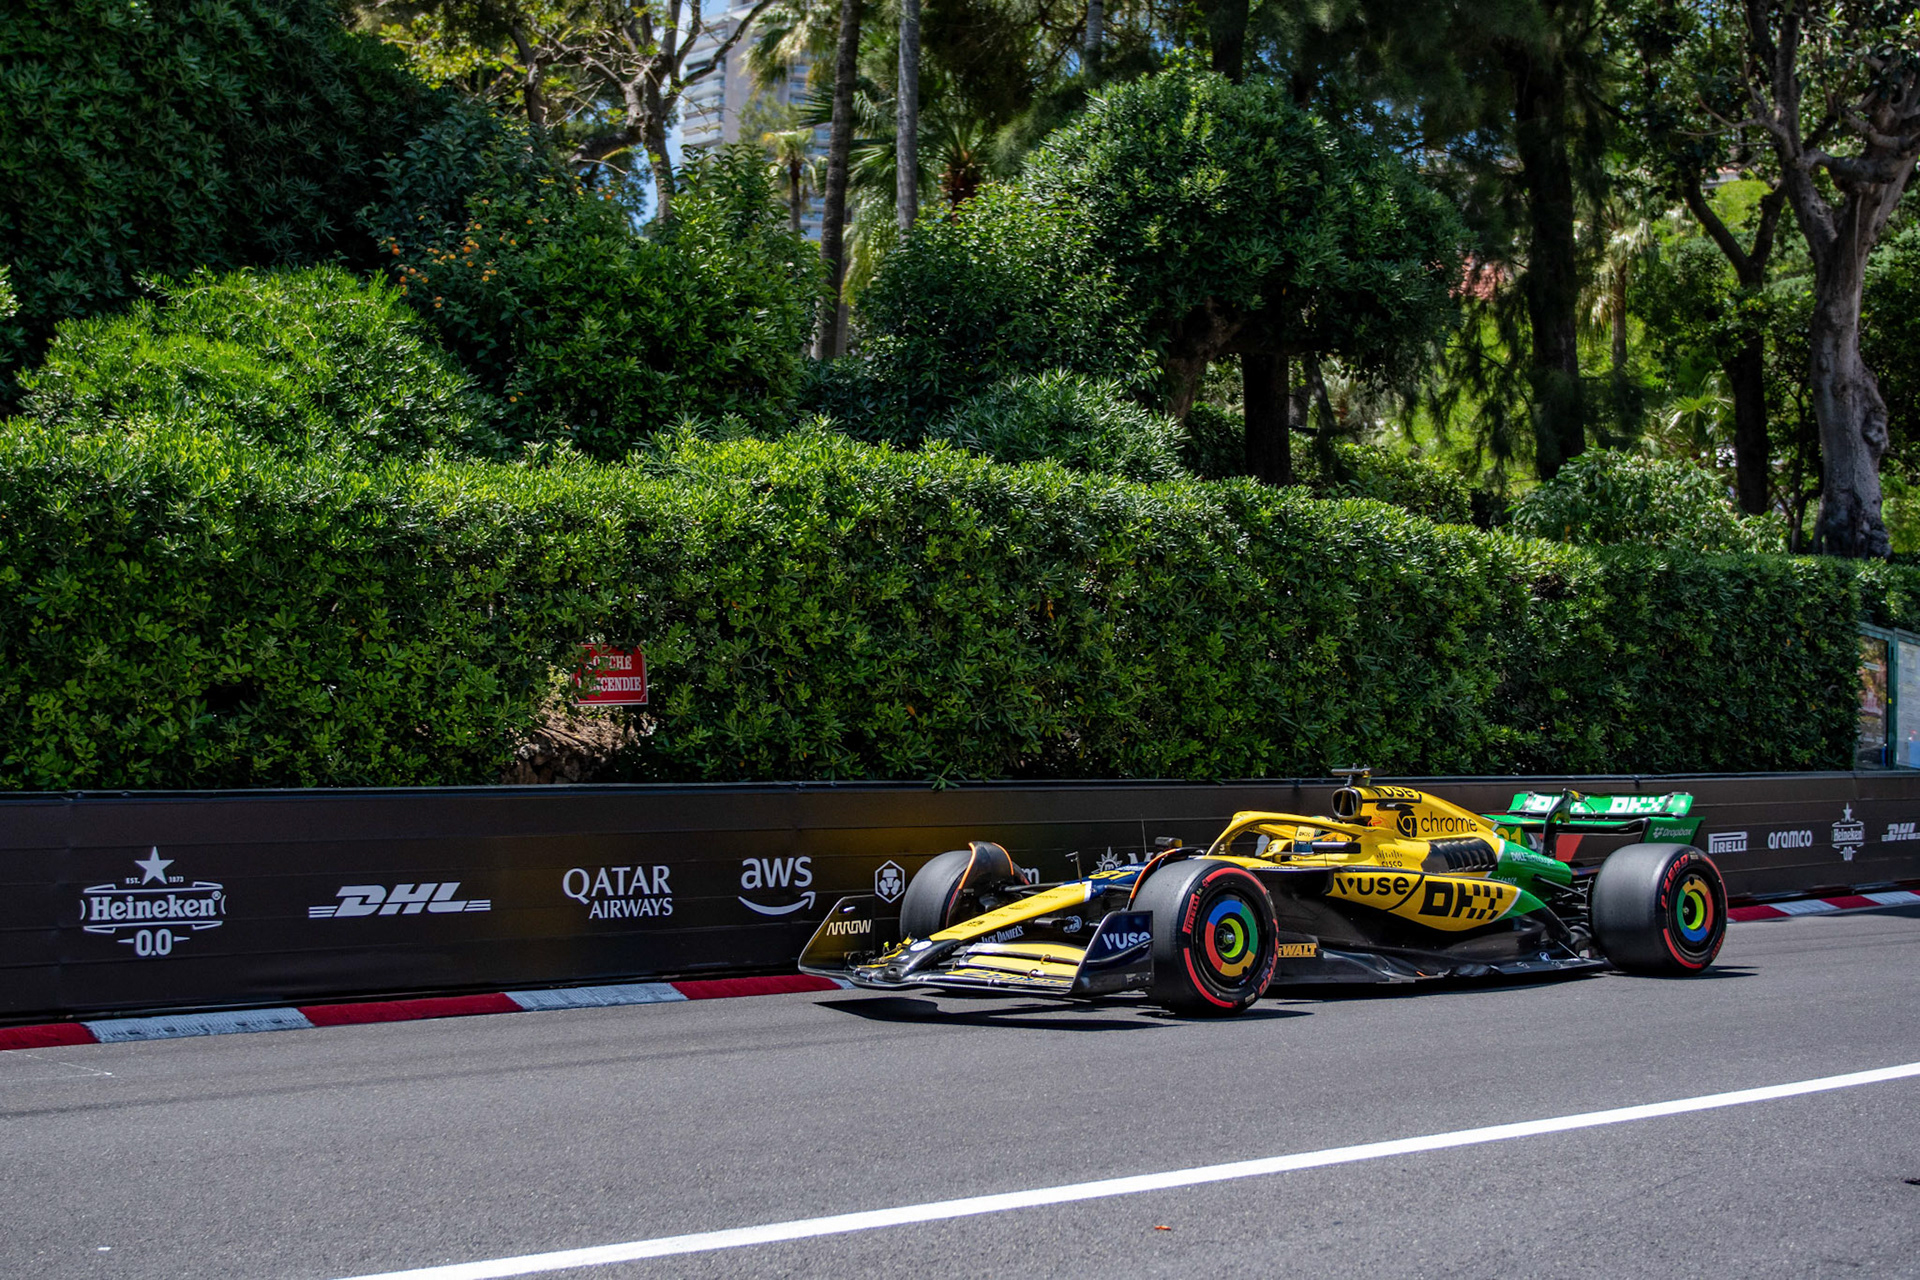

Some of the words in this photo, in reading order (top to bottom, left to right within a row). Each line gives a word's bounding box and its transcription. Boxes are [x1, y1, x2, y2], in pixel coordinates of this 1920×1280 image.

[1420, 811, 1478, 833] chrome
[1662, 827, 1693, 838] Dropbox
[1886, 822, 1916, 841] DHL
[1708, 831, 1748, 854] PIRELLI
[1767, 830, 1813, 850] aramco
[1833, 828, 1863, 842] Heineken
[740, 856, 813, 890] aws
[562, 865, 673, 905] QATAR
[90, 894, 217, 921] Heineken
[333, 882, 468, 918] DHL
[588, 897, 674, 919] AIRWAYS
[1418, 880, 1503, 921] OKX
[136, 929, 172, 957] 0.0
